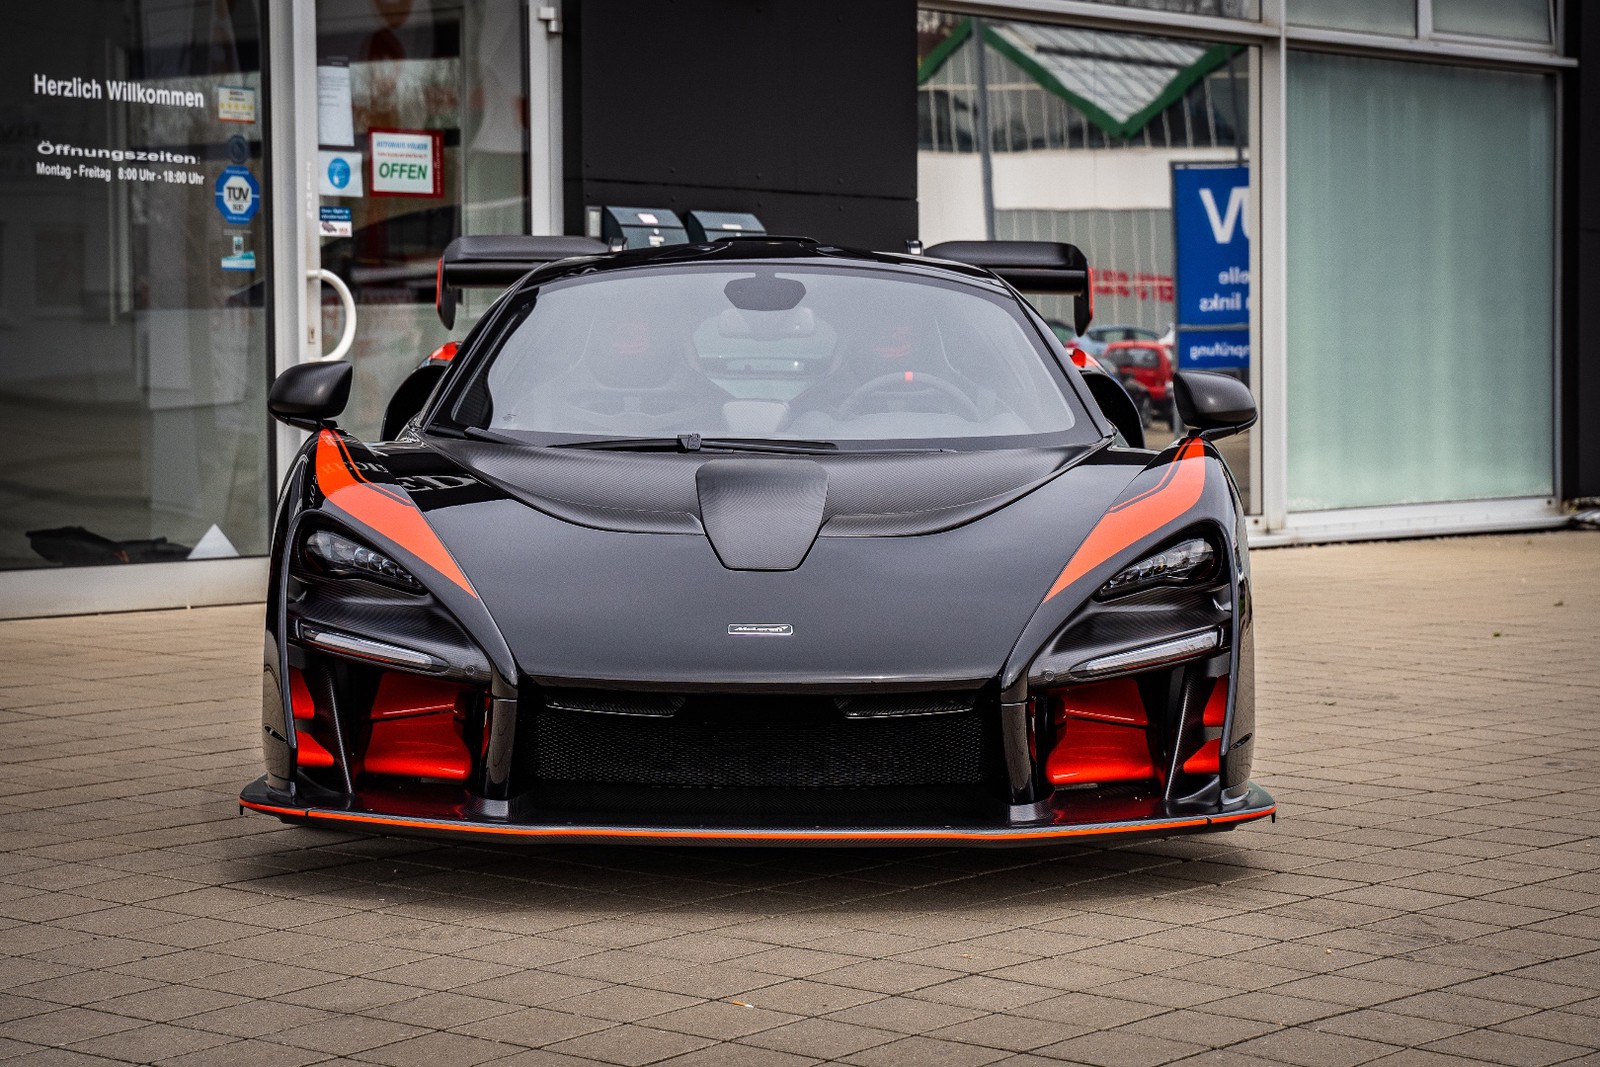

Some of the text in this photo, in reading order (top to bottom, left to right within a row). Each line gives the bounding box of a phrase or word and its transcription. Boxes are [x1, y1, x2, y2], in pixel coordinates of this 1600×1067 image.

[34, 73, 204, 108] Herzlich Willkommen
[37, 140, 201, 165] Öffnungszeiten:
[36, 162, 71, 179] Montag
[79, 164, 111, 182] Freitag
[117, 167, 137, 180] 8:00
[138, 169, 156, 181] Uhr
[163, 170, 187, 184] 18:00
[188, 172, 205, 185] Uhr
[379, 162, 428, 179] OFFEN
[226, 186, 250, 201] TÜV
